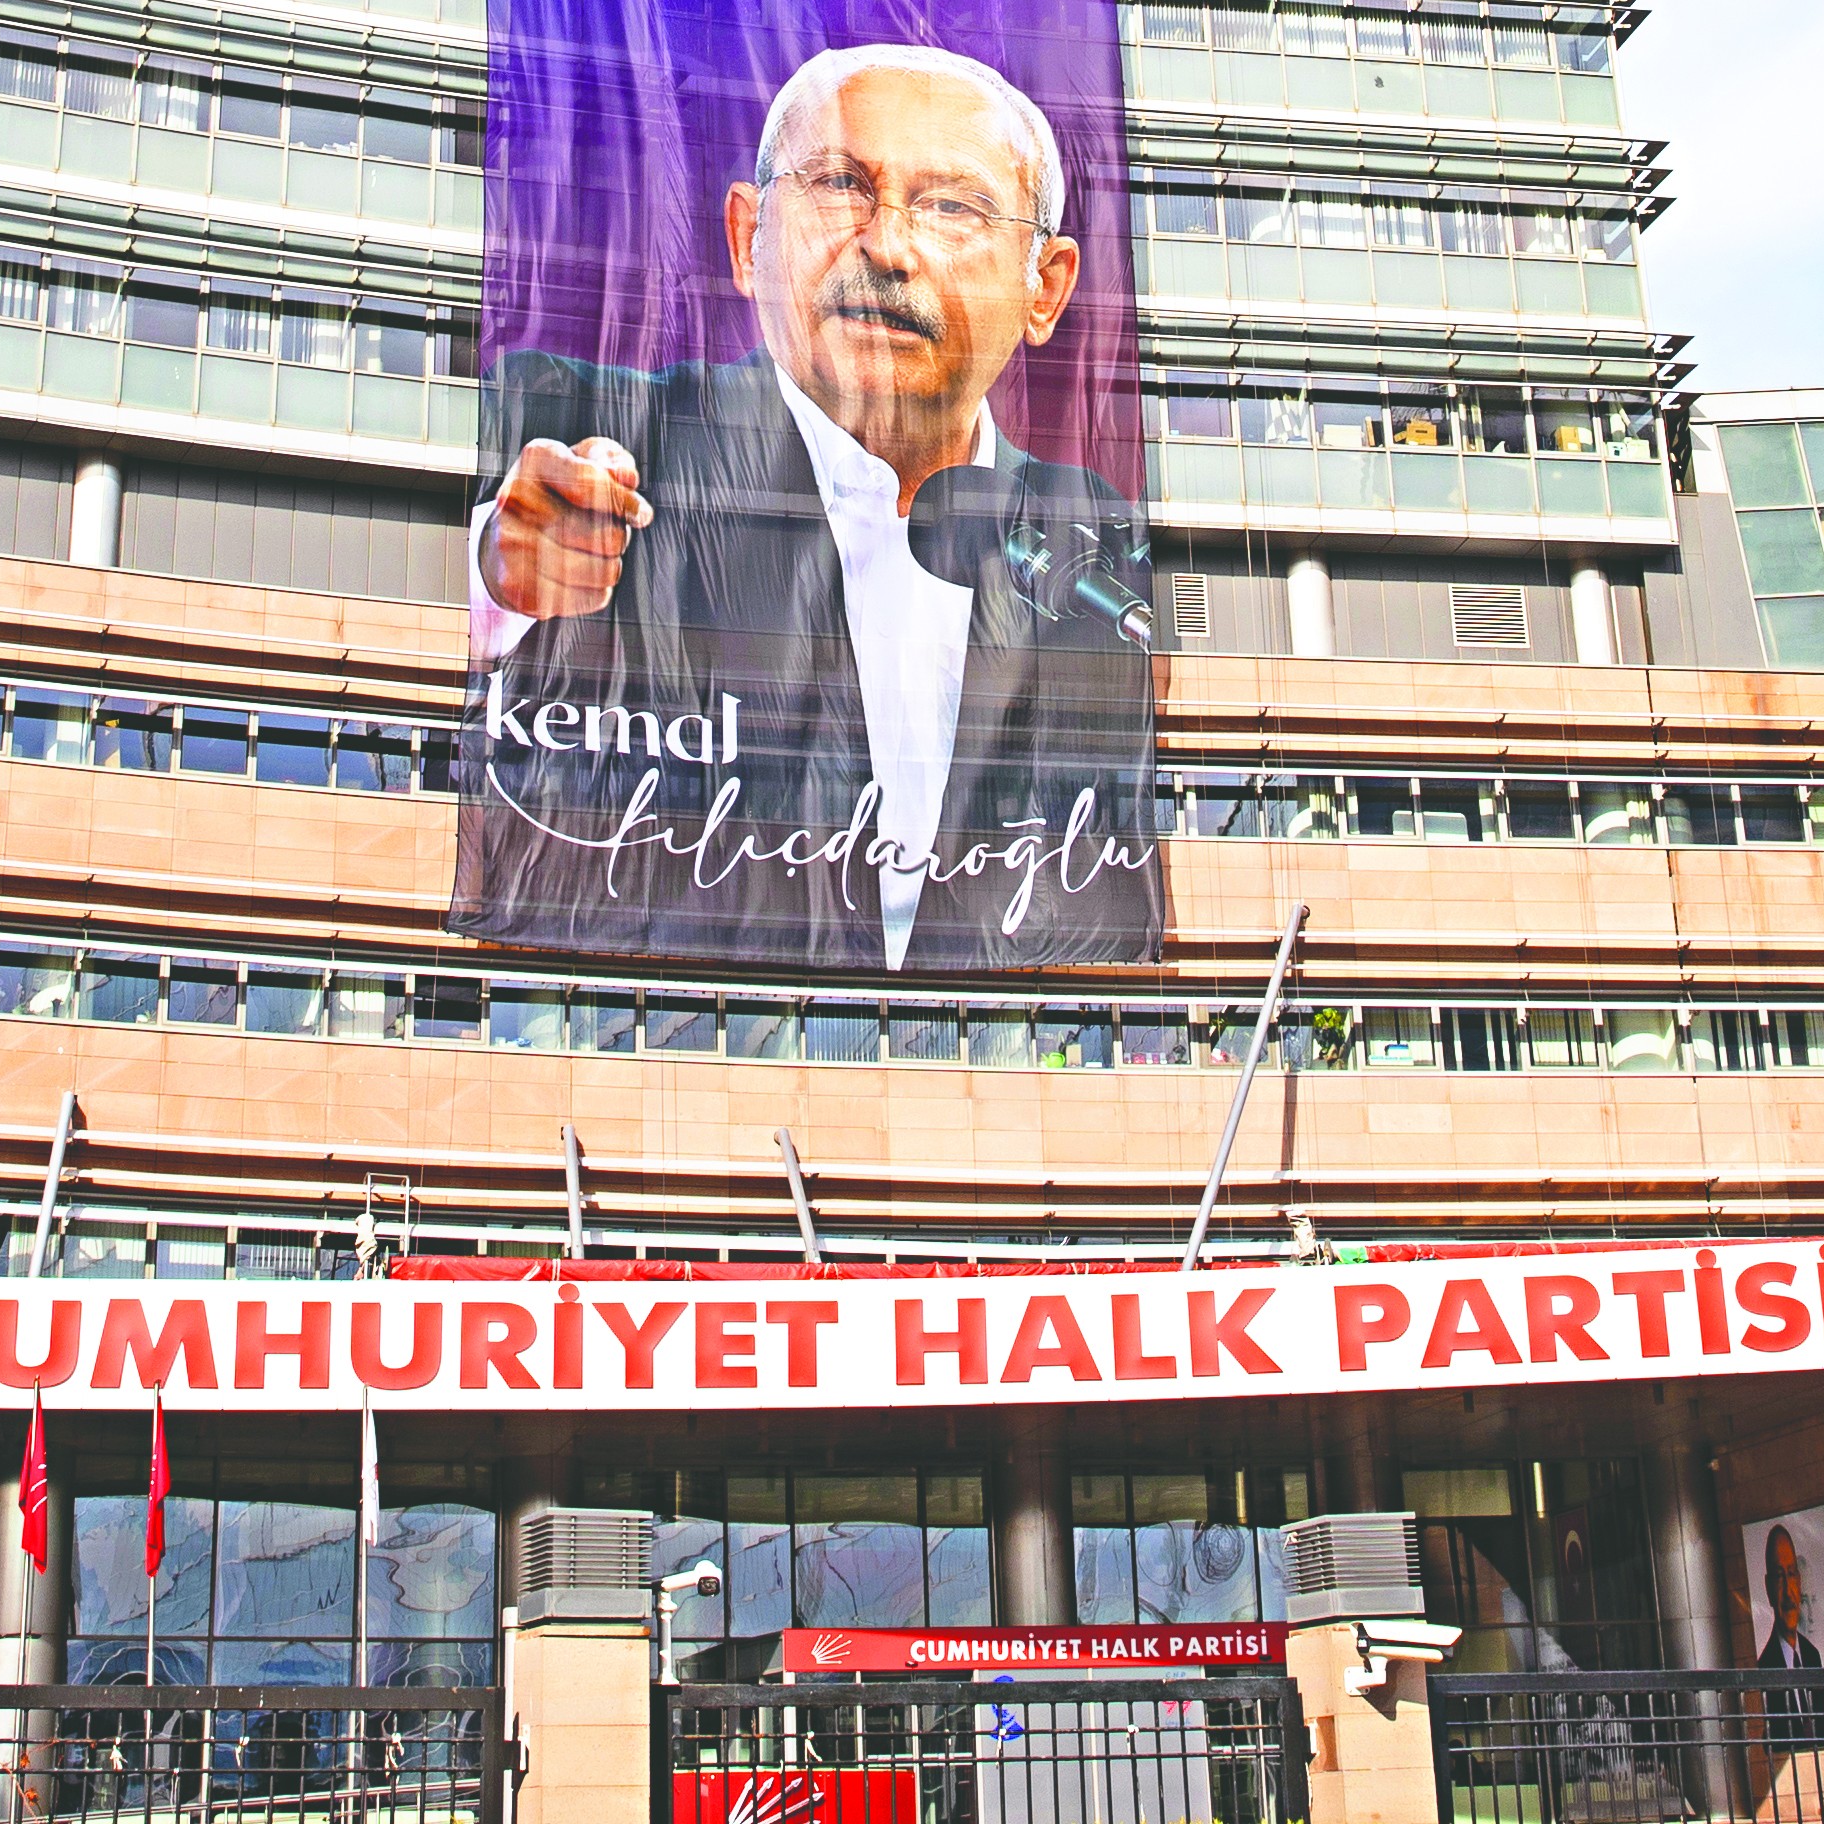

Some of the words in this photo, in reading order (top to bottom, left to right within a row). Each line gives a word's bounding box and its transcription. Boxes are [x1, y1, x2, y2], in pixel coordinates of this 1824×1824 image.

[486, 670, 741, 765] kemal
[893, 1286, 1284, 1386] HALK
[910, 1633, 1082, 1662] CUMHURİYET
[1091, 1637, 1161, 1659] HALK
[1169, 1629, 1269, 1657] PARTİSİ
